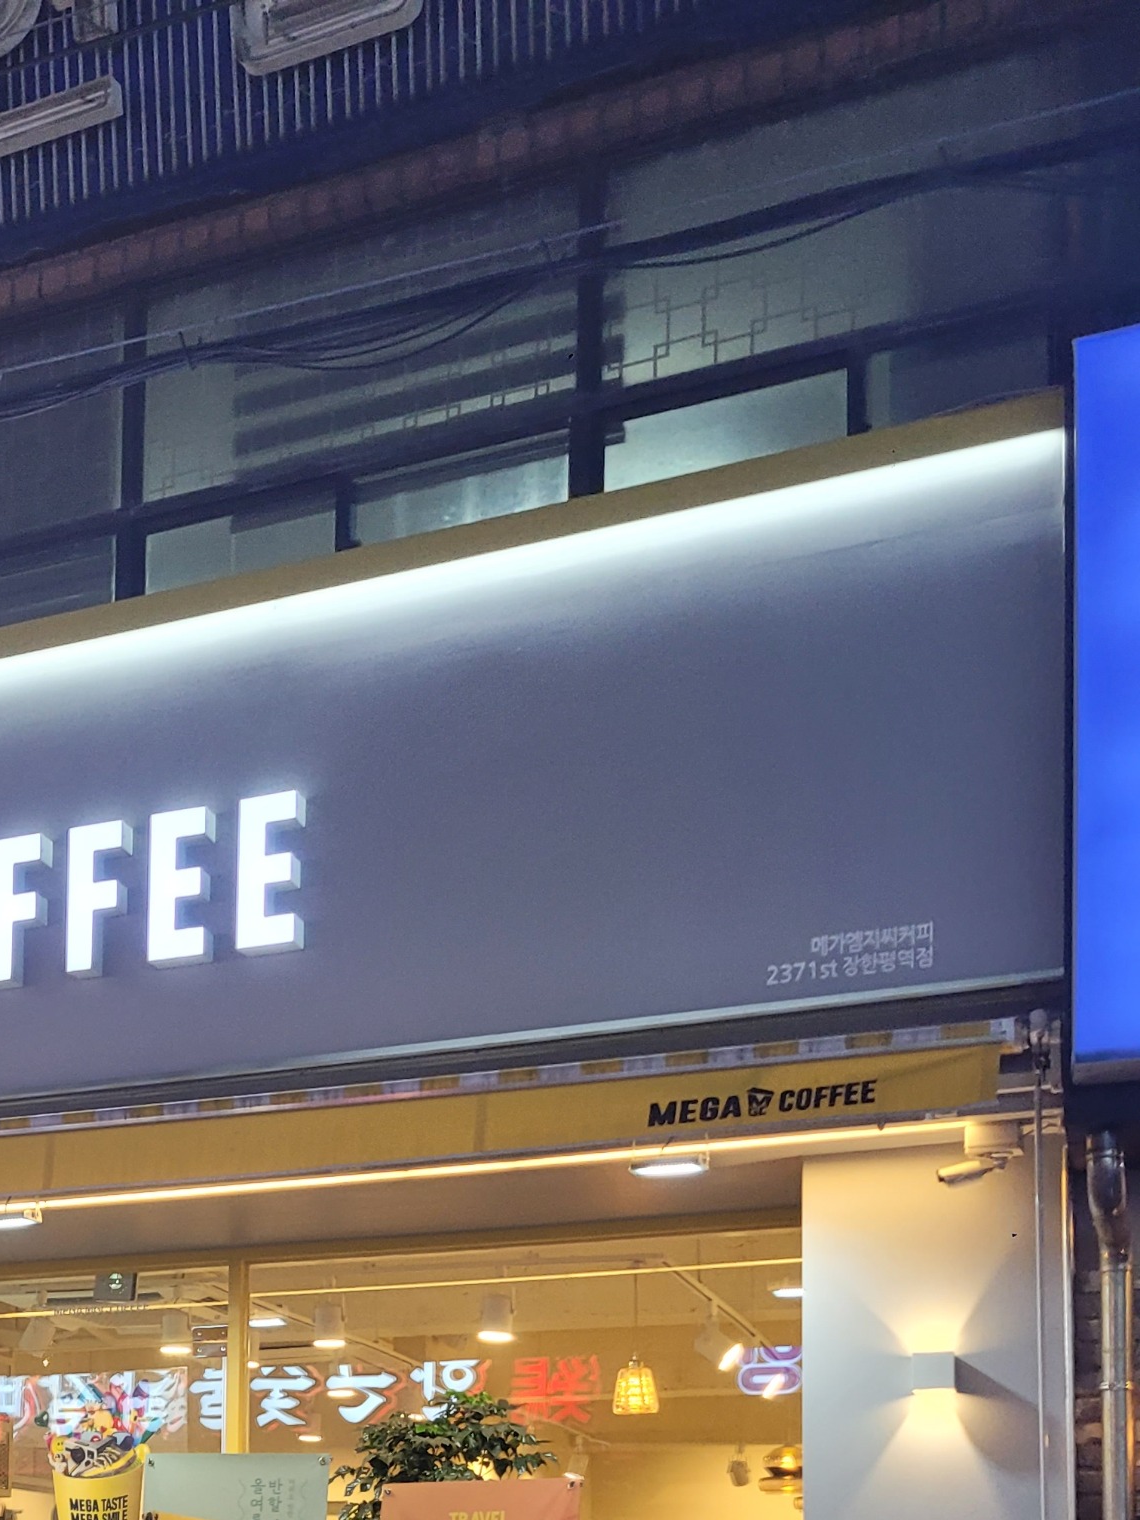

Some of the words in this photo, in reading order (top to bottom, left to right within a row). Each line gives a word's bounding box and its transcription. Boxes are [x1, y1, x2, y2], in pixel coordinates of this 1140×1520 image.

[810, 920, 934, 956] 메가엠지씨커피
[766, 959, 838, 986] 2371st
[842, 946, 934, 978] 장한평역점
[647, 1094, 742, 1128] MEGA
[778, 1078, 878, 1112] COFFEE
[70, 1498, 99, 1512] MEGA
[101, 1495, 128, 1511] TASTE
